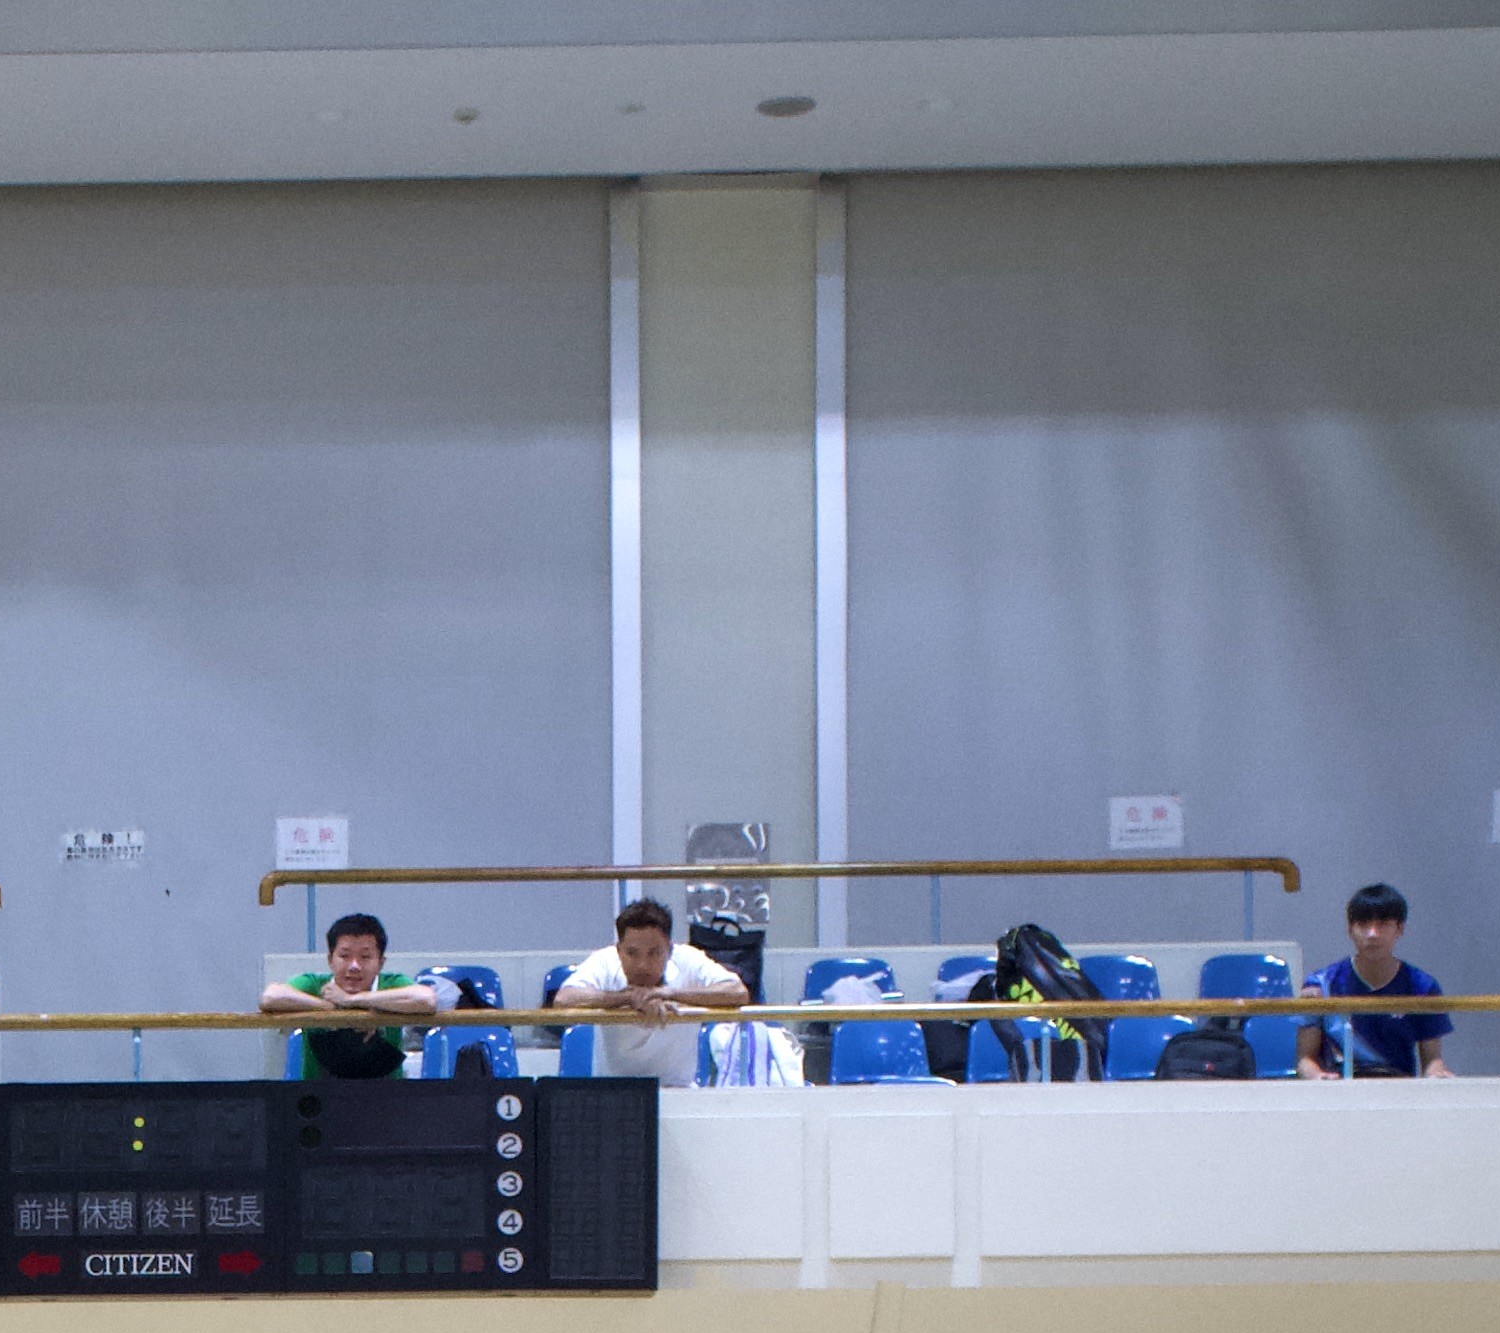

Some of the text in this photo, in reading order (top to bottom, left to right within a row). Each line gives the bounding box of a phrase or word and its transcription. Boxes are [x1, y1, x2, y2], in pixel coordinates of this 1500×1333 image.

[18, 1194, 263, 1231] 前半 休憩 後半 延長
[84, 1252, 195, 1278] CITIZEN
